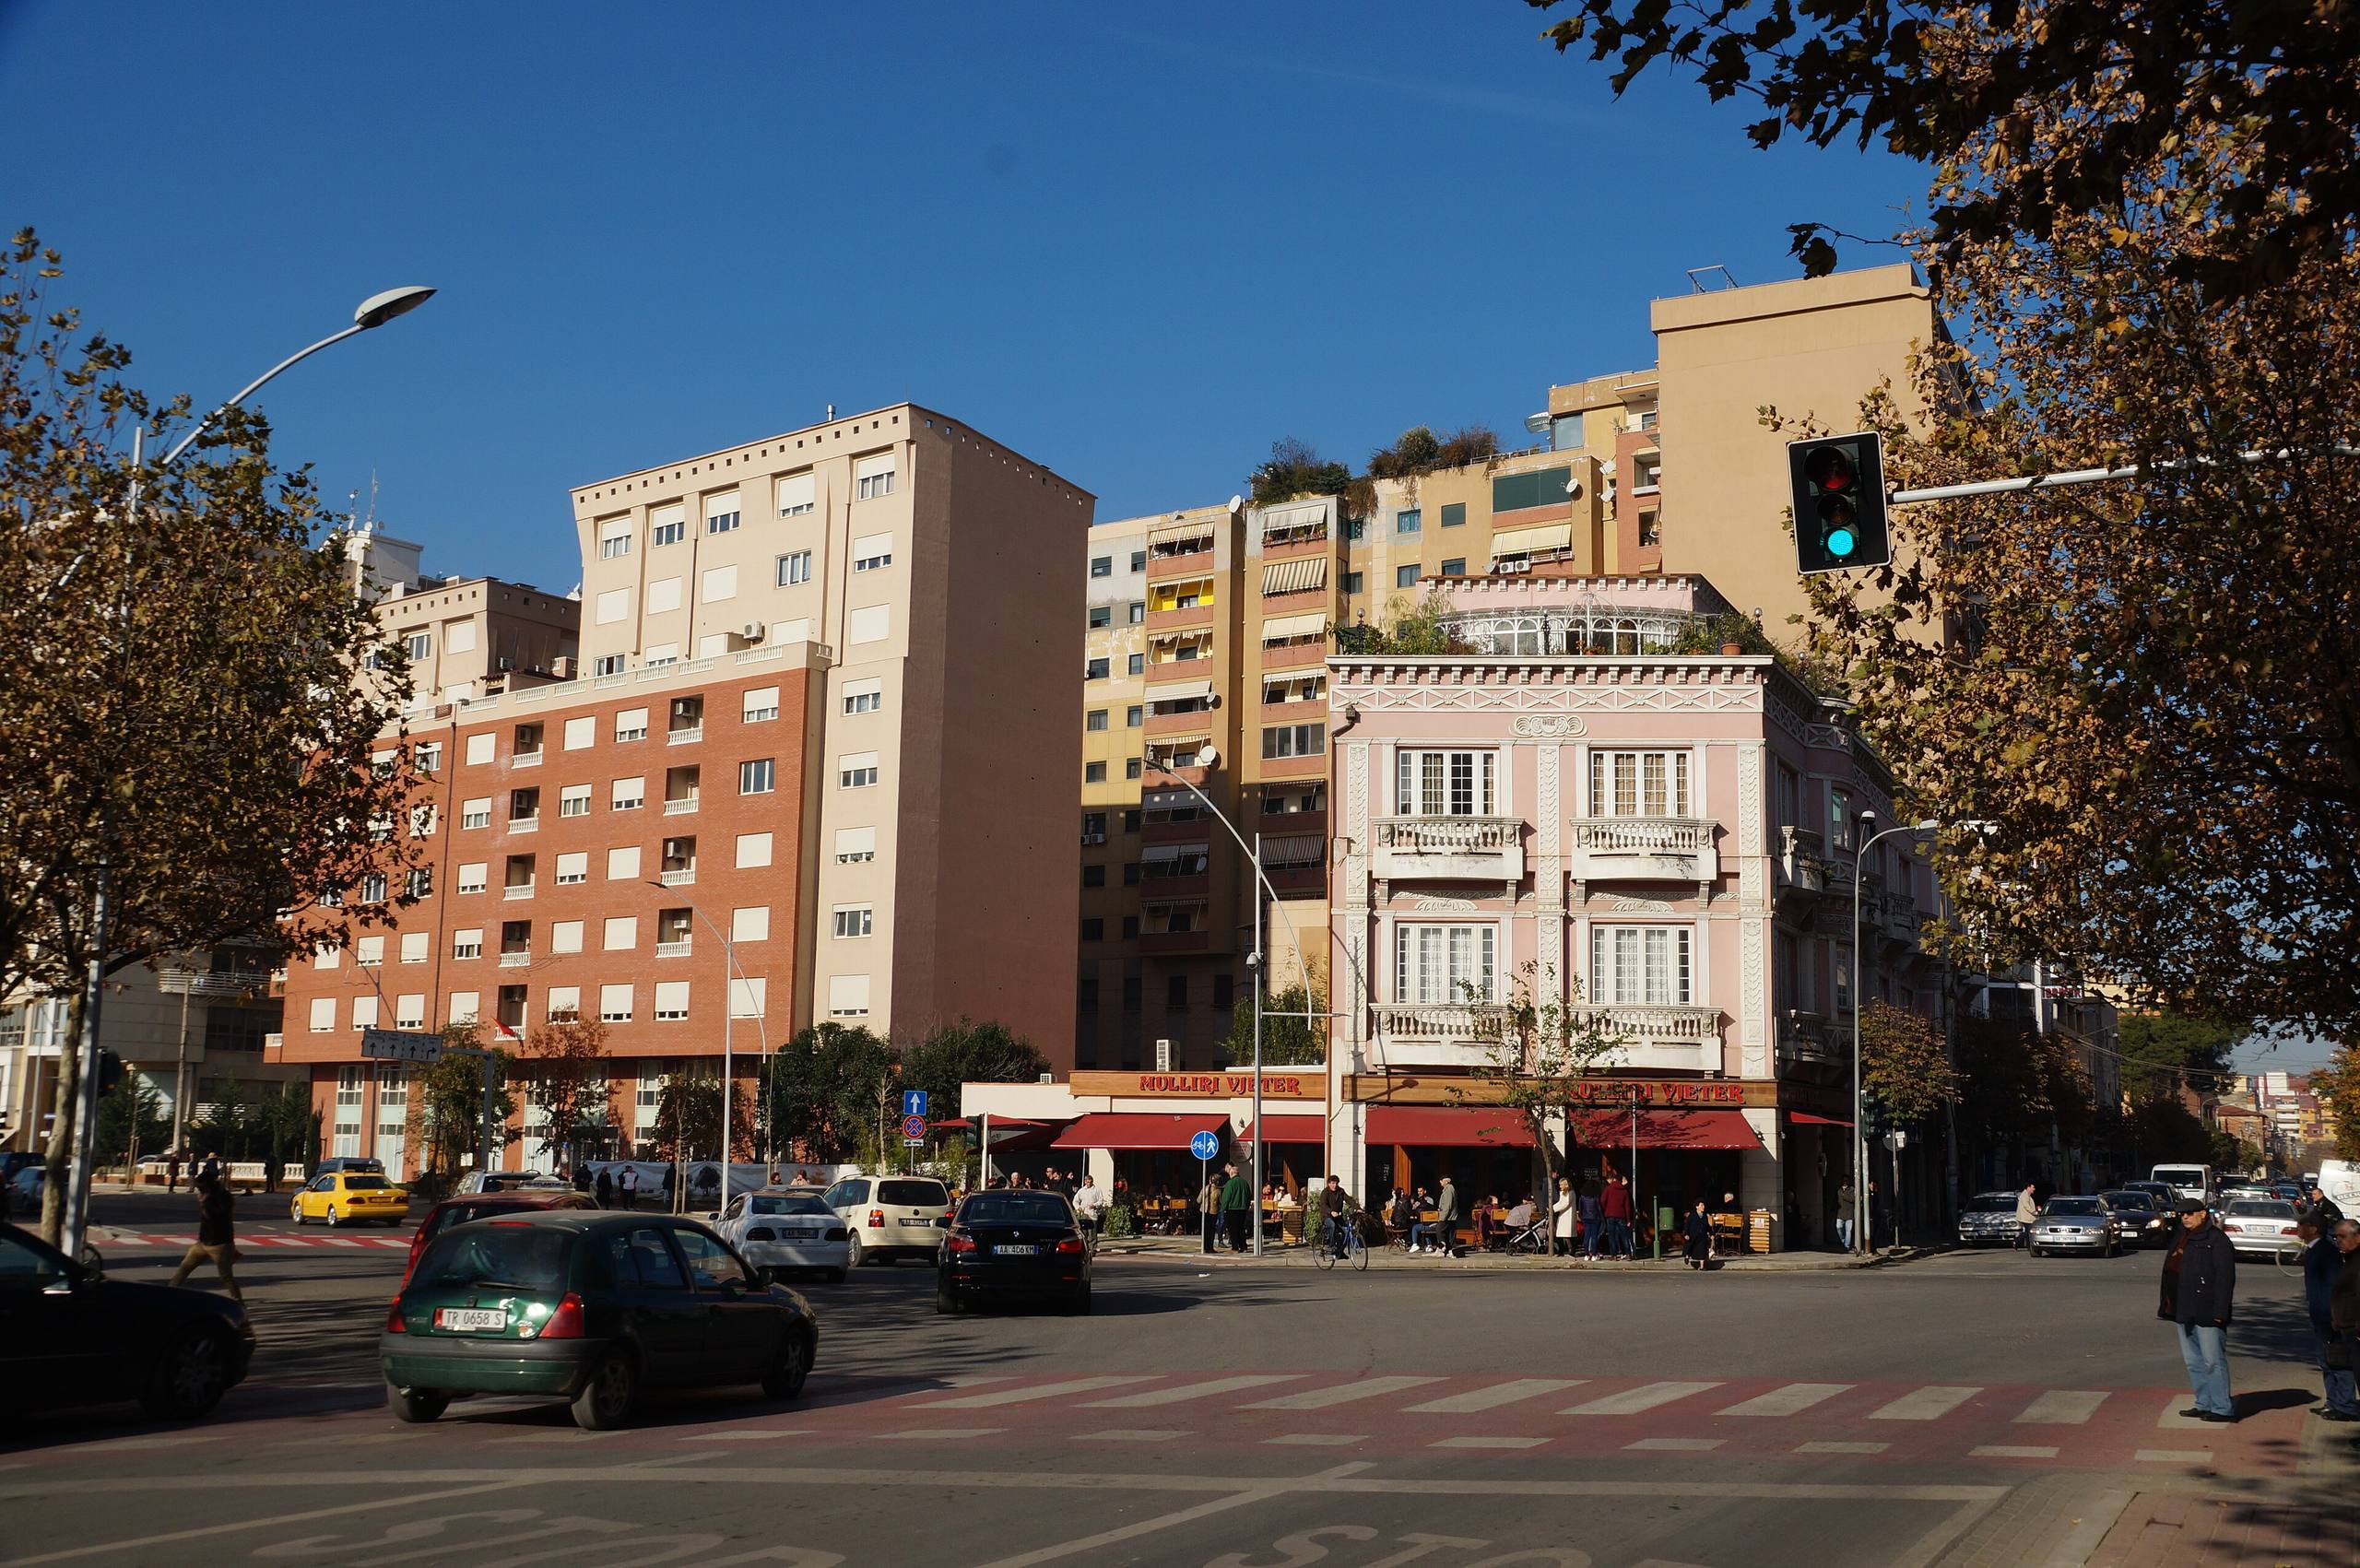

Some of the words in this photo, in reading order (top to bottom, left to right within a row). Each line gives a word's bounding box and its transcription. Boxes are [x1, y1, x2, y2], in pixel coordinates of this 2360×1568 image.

[1139, 1076, 1220, 1094] MULLIRI
[1227, 1076, 1302, 1095] VJETER
[1564, 1082, 1654, 1102] ULLIRI
[1661, 1082, 1746, 1104] VJETER
[999, 1245, 1009, 1254] AA
[1011, 1245, 1024, 1254] 406
[446, 1311, 459, 1325] TR
[463, 1312, 490, 1326] 0658
[494, 1313, 502, 1326] S
